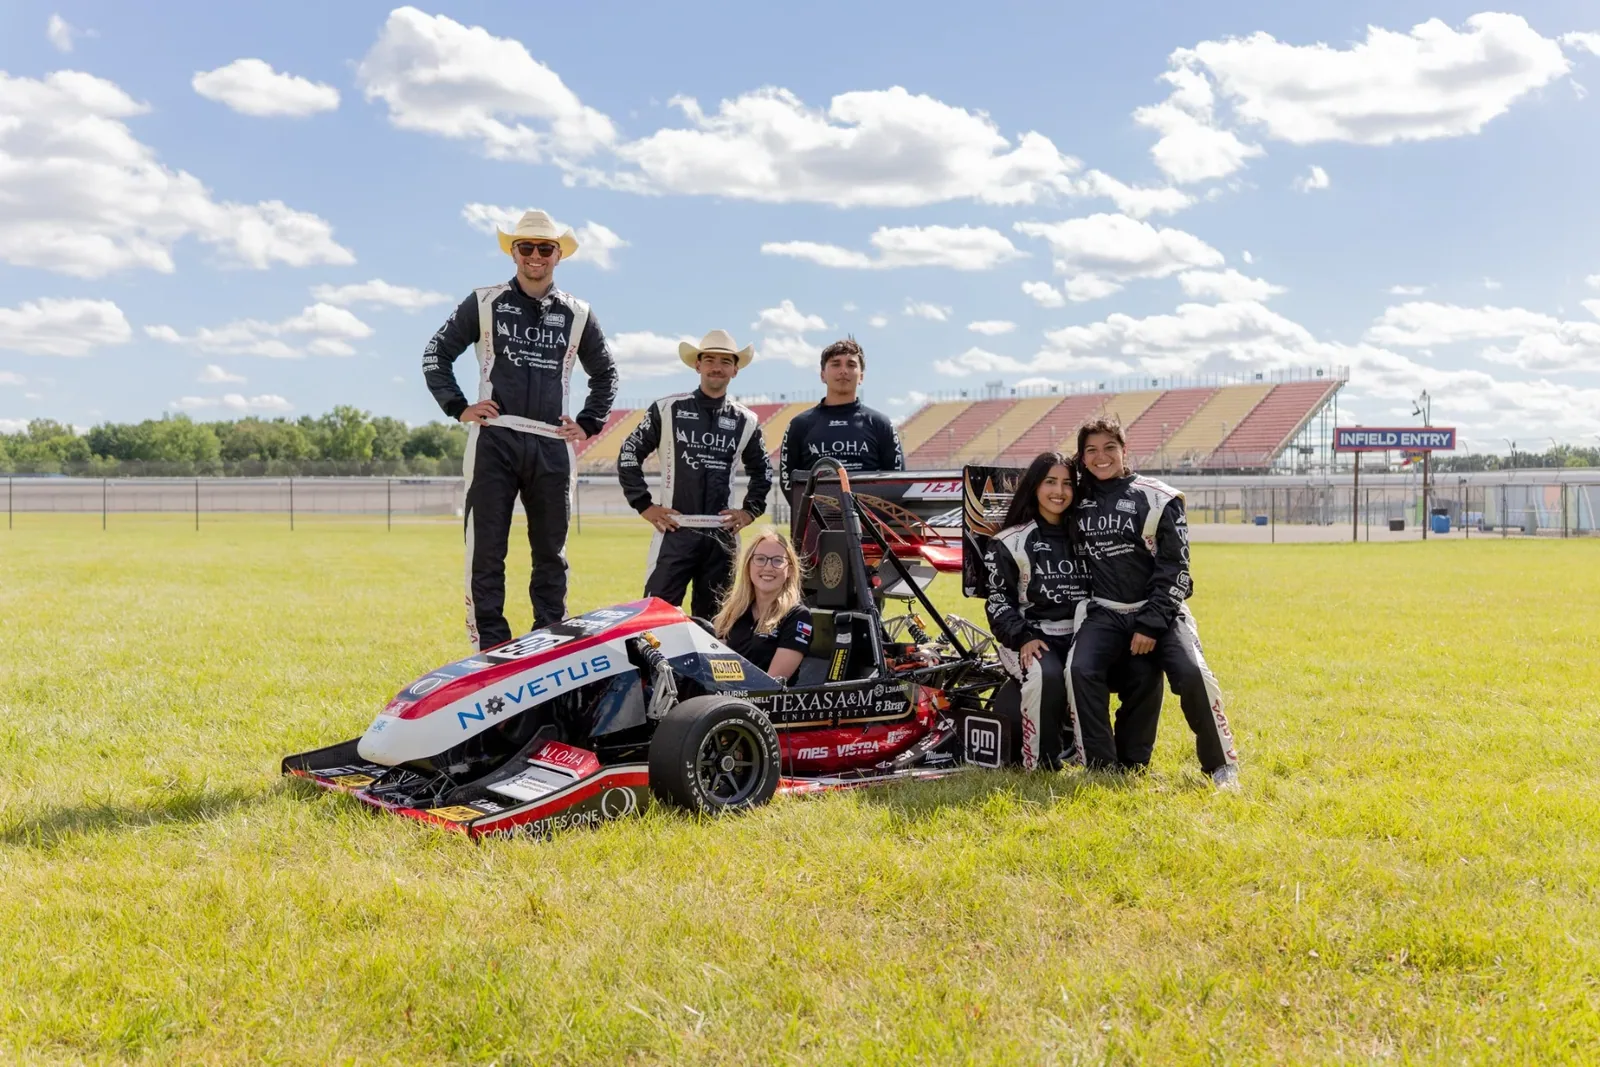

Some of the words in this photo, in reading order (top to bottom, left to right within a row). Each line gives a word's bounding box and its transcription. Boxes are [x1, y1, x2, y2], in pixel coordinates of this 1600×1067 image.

[497, 320, 567, 346] ALOHA
[675, 427, 736, 450] ALOHA
[1340, 432, 1398, 446] INFIELD
[1400, 432, 1451, 446] ENTRY
[808, 440, 870, 455] ALOHA
[1076, 513, 1135, 534] ALOHA
[712, 661, 742, 674] ROMCO
[457, 655, 611, 730] NOVETUS
[722, 690, 748, 698] BURNS
[769, 691, 834, 713] TEXAS
[833, 689, 874, 710] A&M
[782, 708, 869, 721] UNIVERSITY
[883, 700, 907, 712] Bray
[539, 743, 585, 766] ALOHA
[837, 740, 880, 758] VISTRA
[571, 809, 599, 825] ONE
